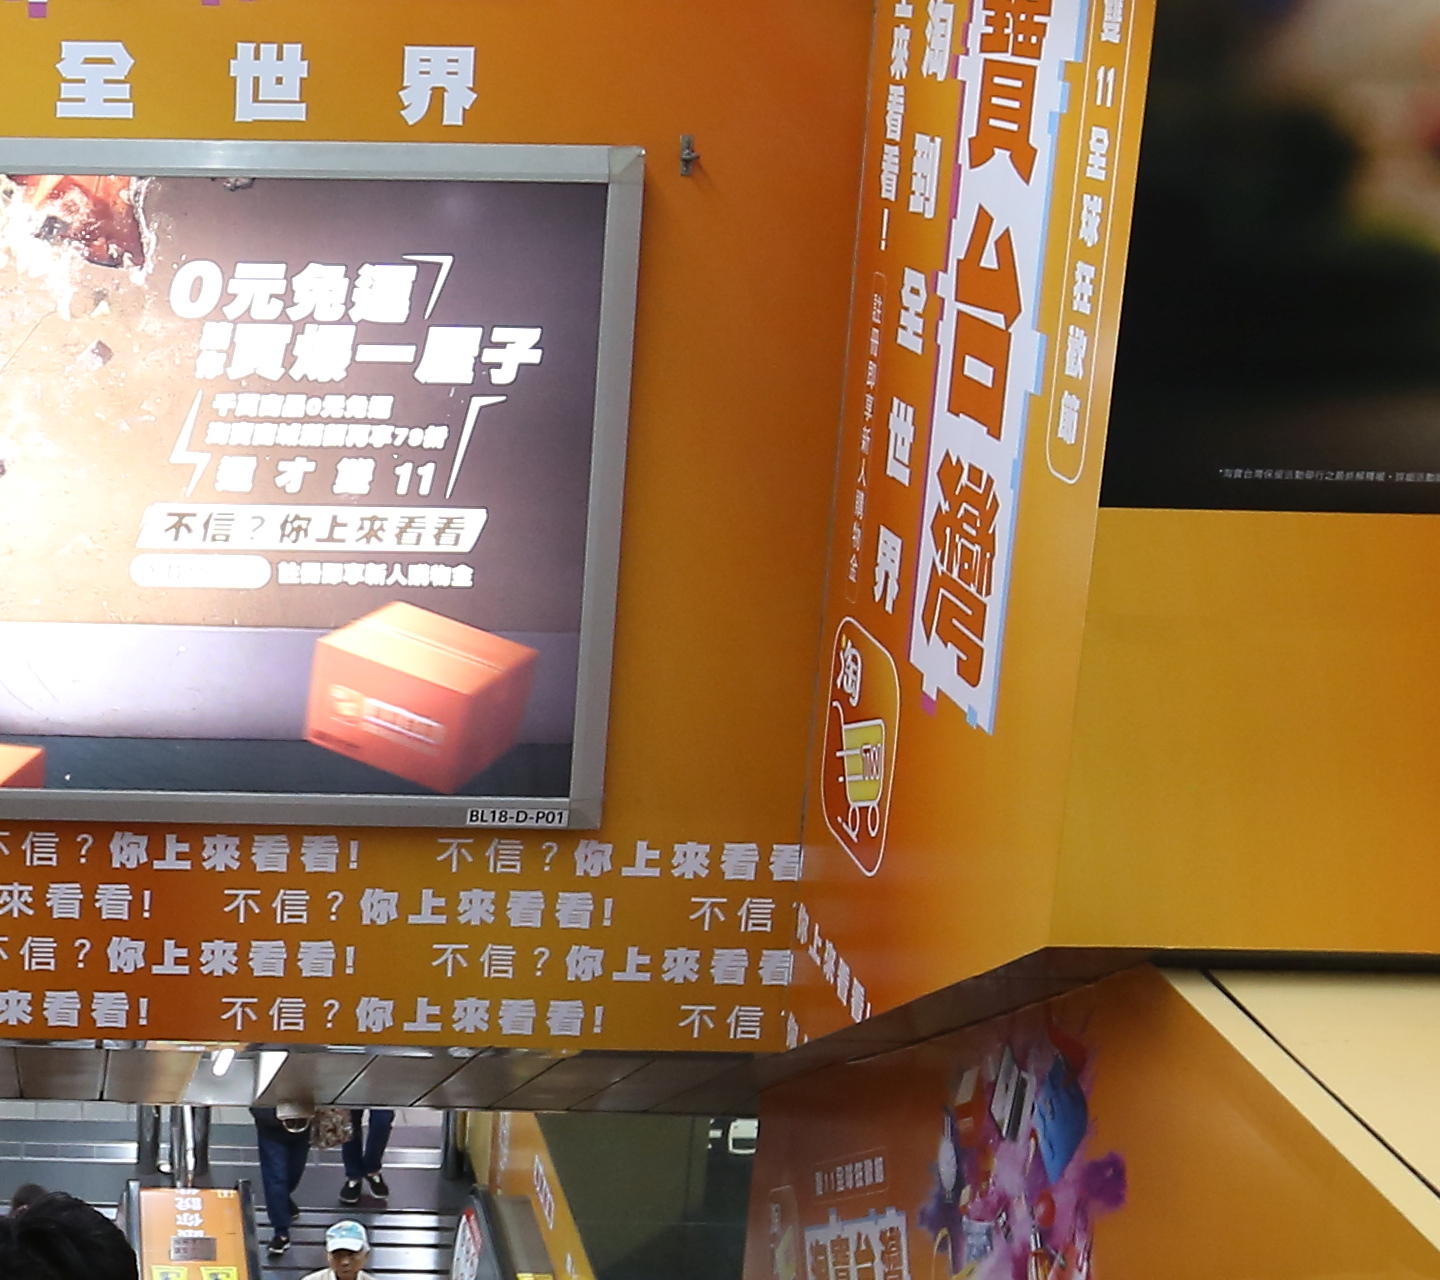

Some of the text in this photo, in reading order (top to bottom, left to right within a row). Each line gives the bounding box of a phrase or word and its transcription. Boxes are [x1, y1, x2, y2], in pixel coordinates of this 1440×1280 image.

[164, 512, 465, 546] 不信？你上來看看
[469, 808, 566, 825] BL18-D-P01
